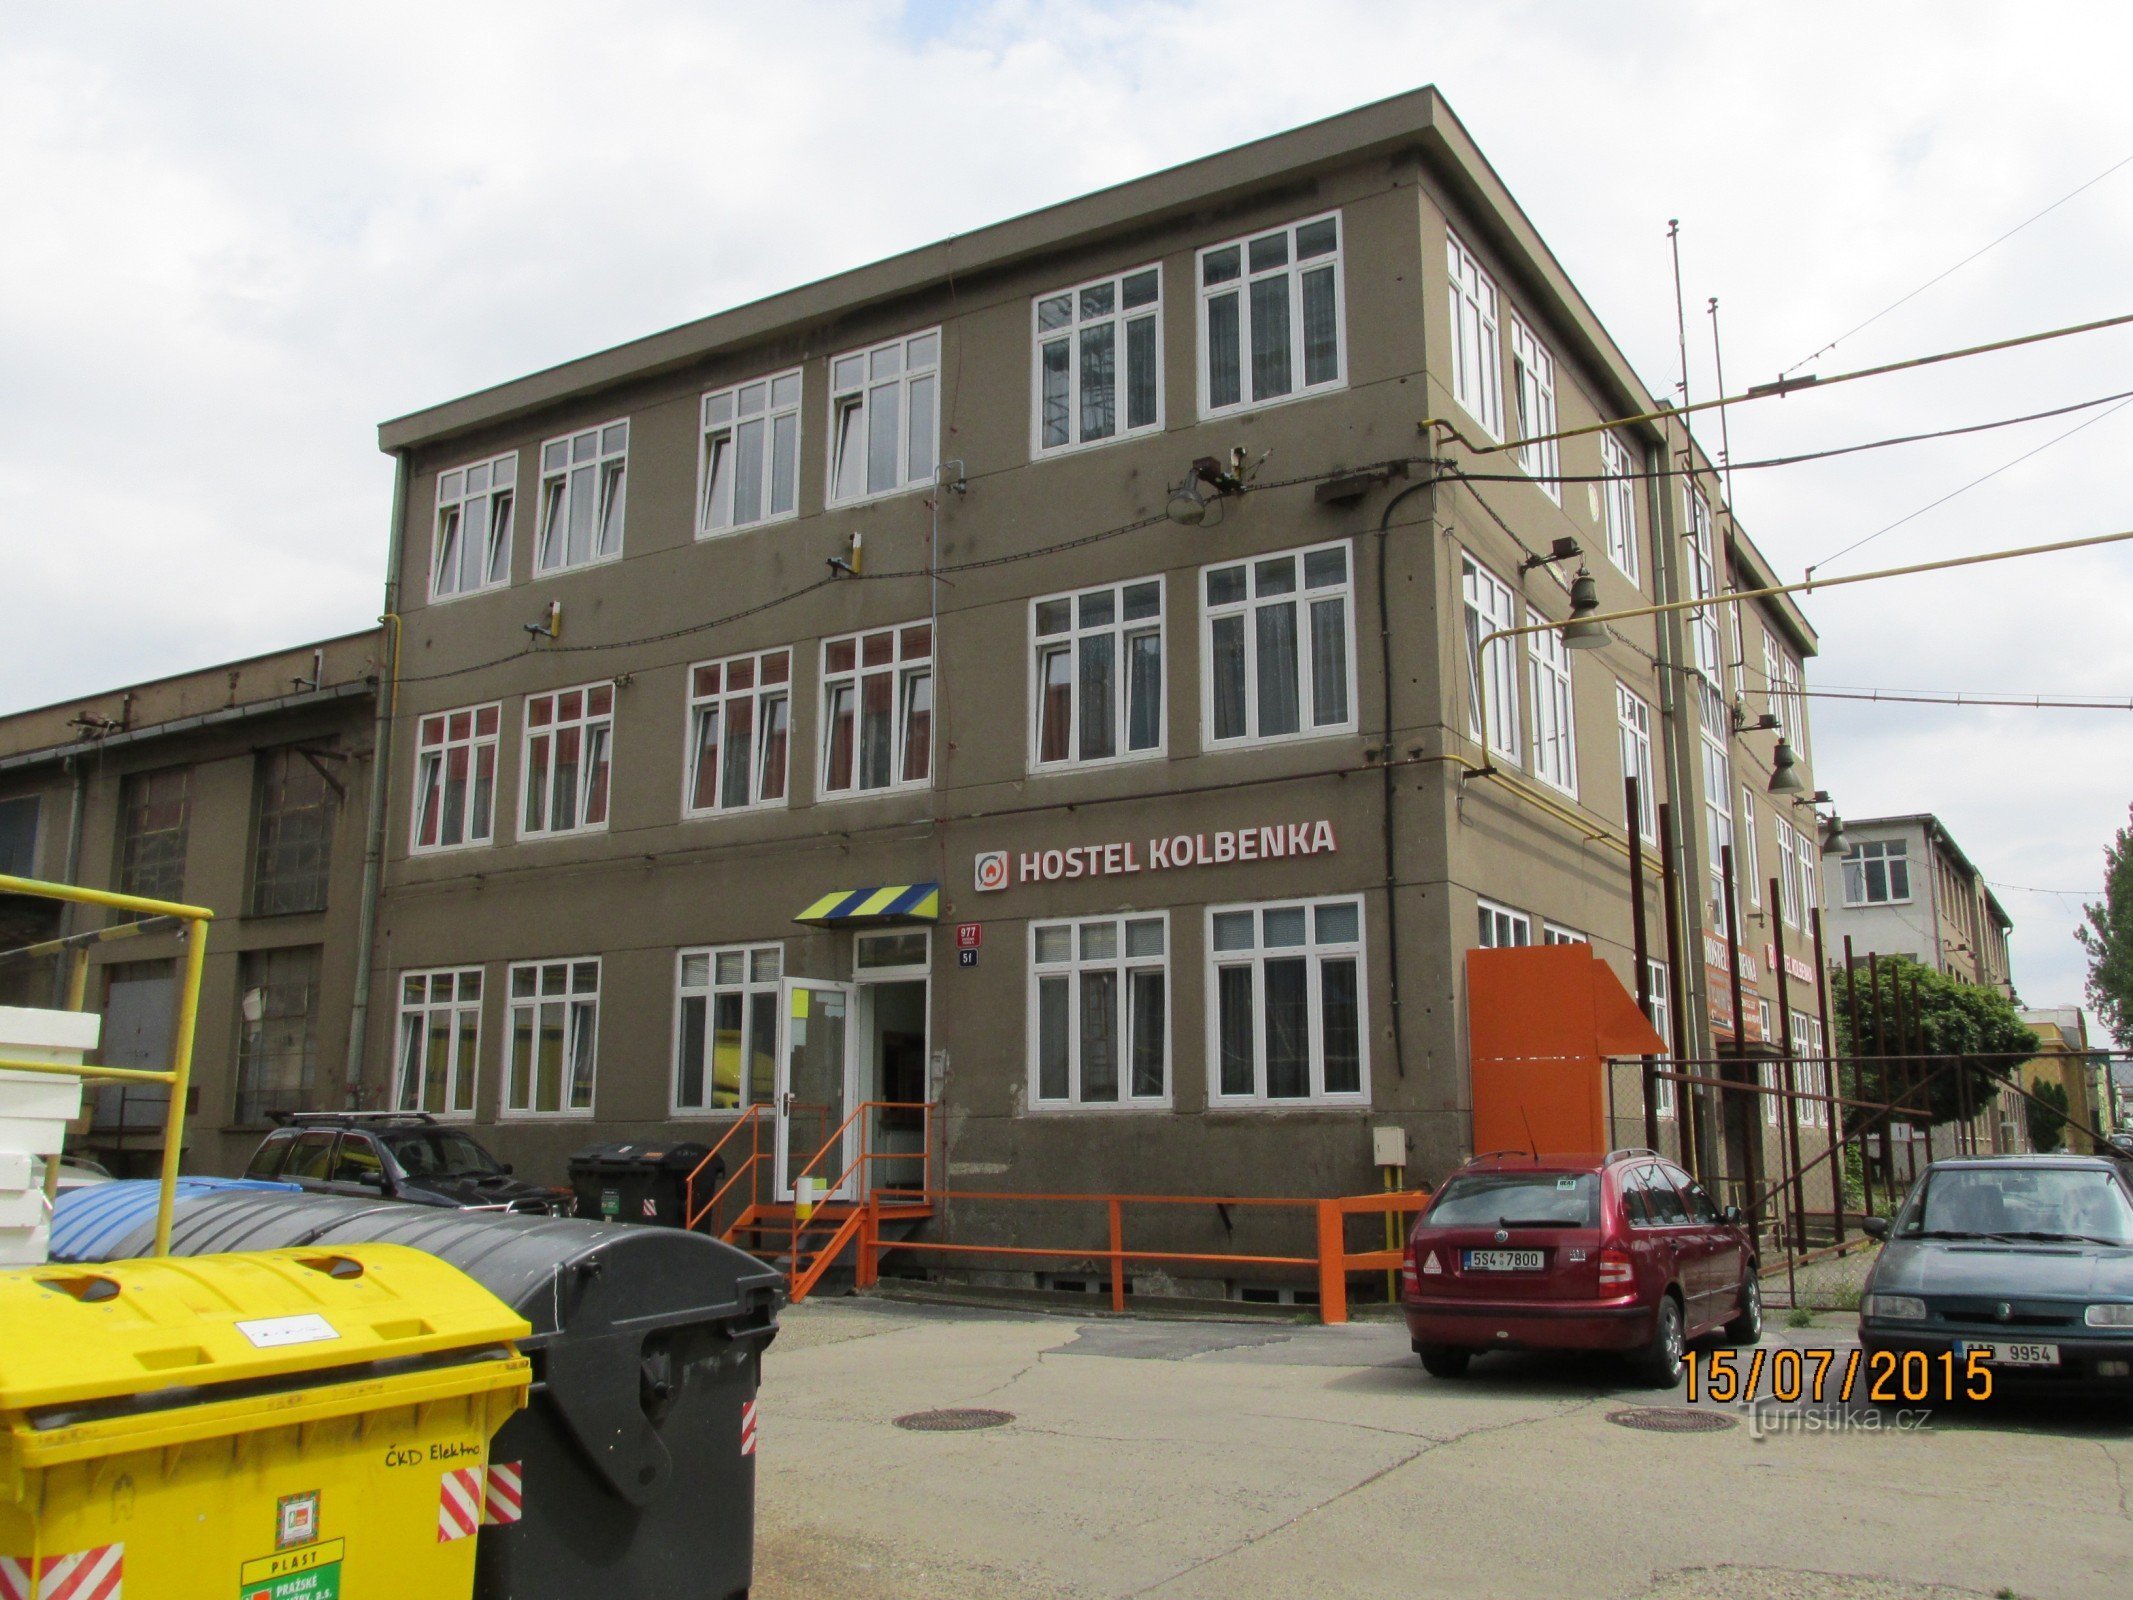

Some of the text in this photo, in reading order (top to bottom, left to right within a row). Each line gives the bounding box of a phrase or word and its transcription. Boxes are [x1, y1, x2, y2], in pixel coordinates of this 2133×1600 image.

[1019, 820, 1337, 882] HOSTEL KOLBENKA
[960, 926, 976, 937] 977
[1703, 936, 1728, 972] HOSTEL
[1474, 1252, 1539, 1267] 5S4 7800
[2009, 1345, 2051, 1362] 9954
[385, 1443, 423, 1467] ČKD
[271, 1551, 317, 1574] PLAST
[276, 1573, 318, 1598] PRAŽSKÉ
